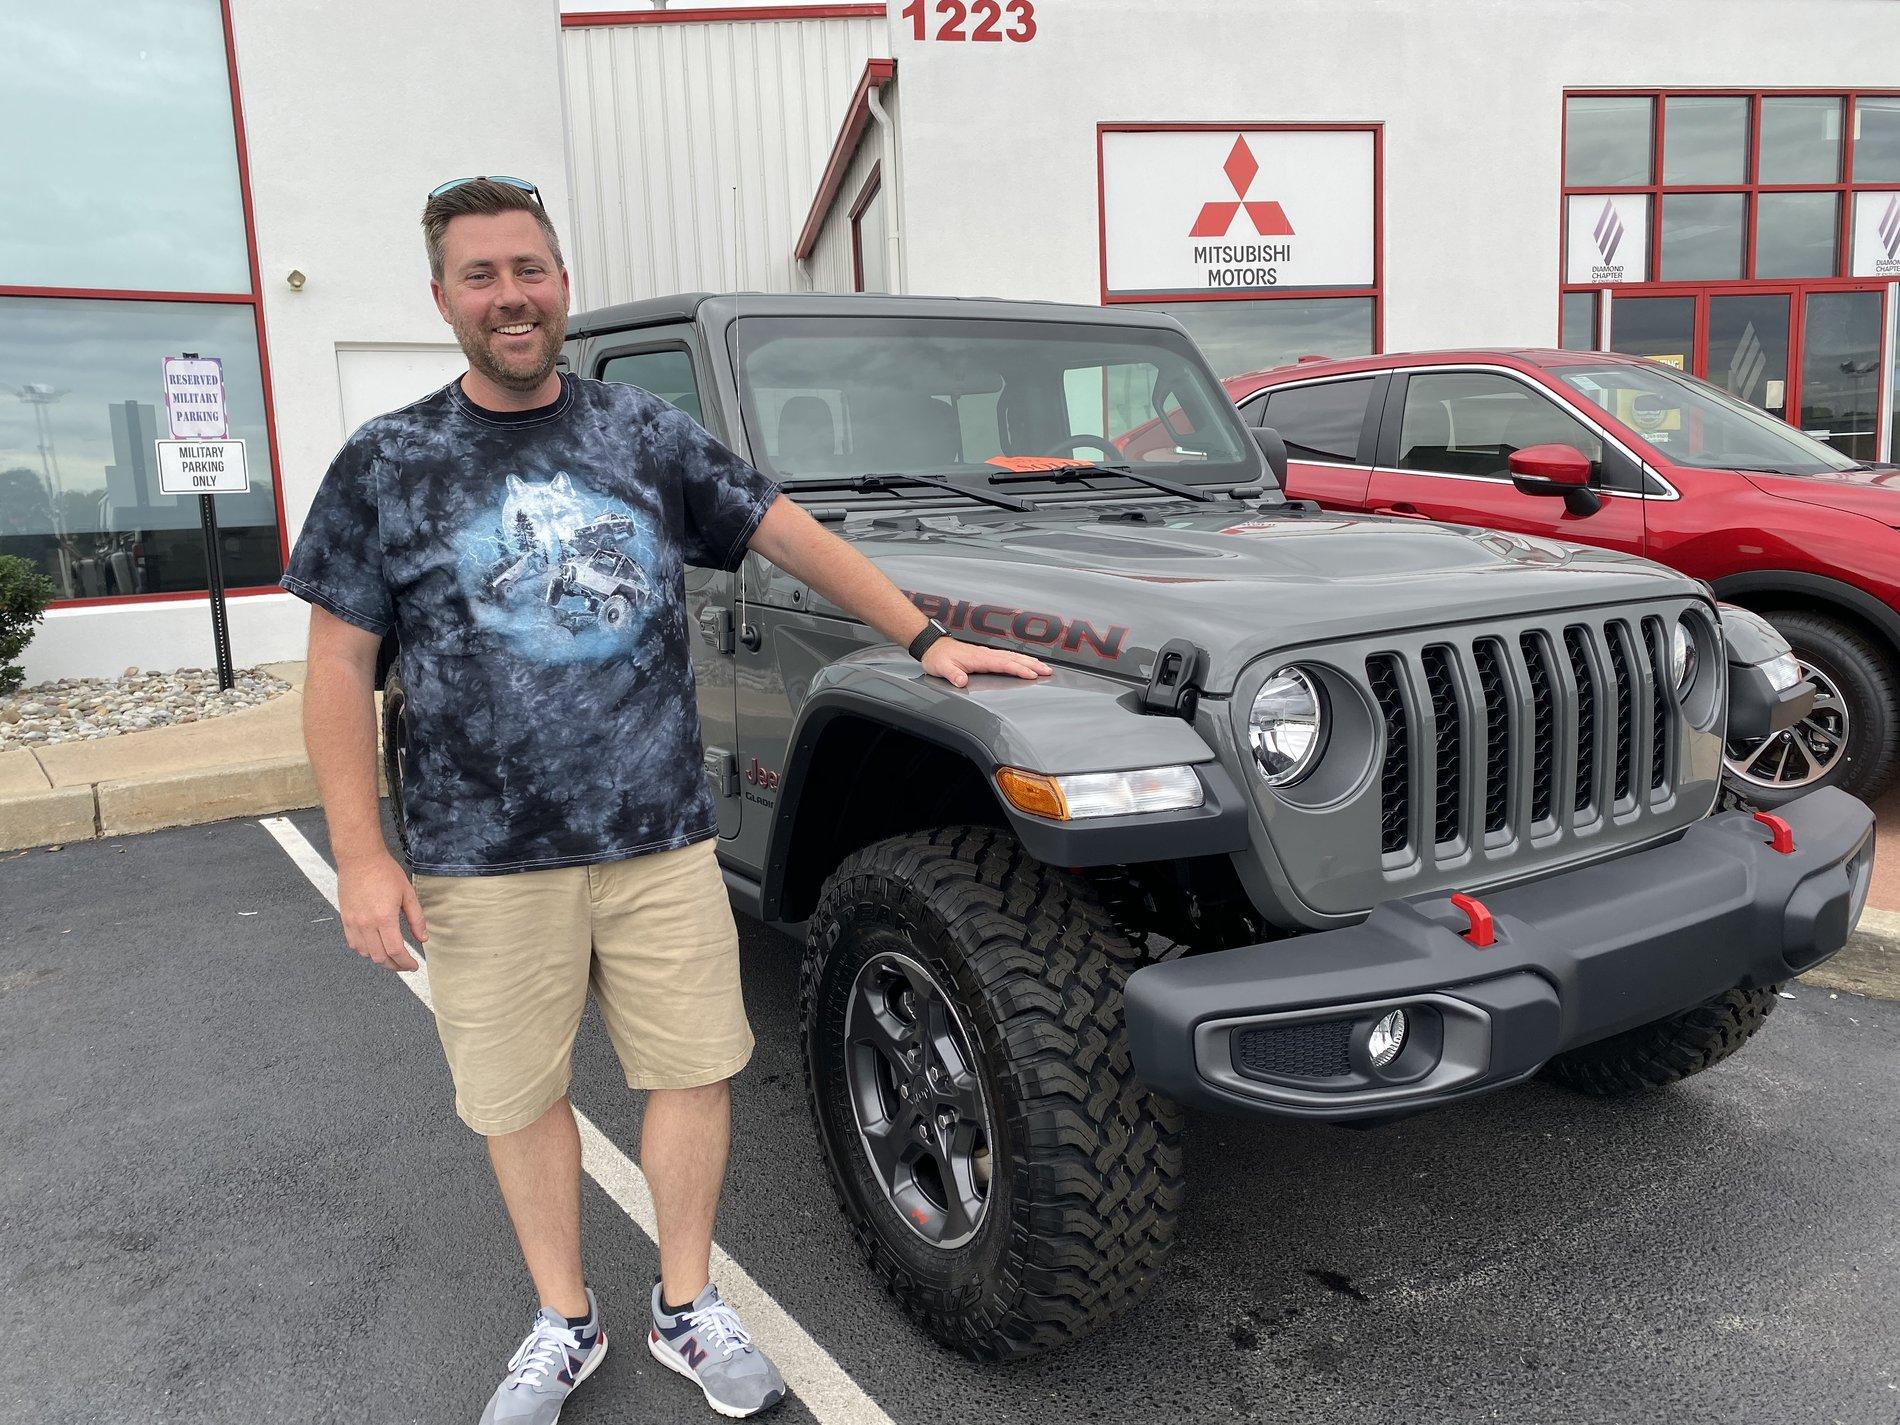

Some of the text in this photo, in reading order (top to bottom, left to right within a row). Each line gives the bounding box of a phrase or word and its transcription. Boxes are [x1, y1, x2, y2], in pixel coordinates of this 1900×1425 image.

[902, 0, 1037, 43] 1223
[1194, 244, 1291, 264] MITSUBISHI
[1591, 265, 1625, 273] DIAMOND
[1208, 267, 1277, 287] MOTORS
[169, 374, 219, 386] RESERVED
[172, 392, 218, 404] MILITARY
[176, 411, 219, 422] PARKING
[179, 446, 224, 458] MILITARY
[182, 461, 225, 473] PARKING
[192, 475, 217, 487] ONLY
[902, 590, 1129, 660] BICON
[745, 757, 781, 790] Jee
[679, 1336, 709, 1370] N
